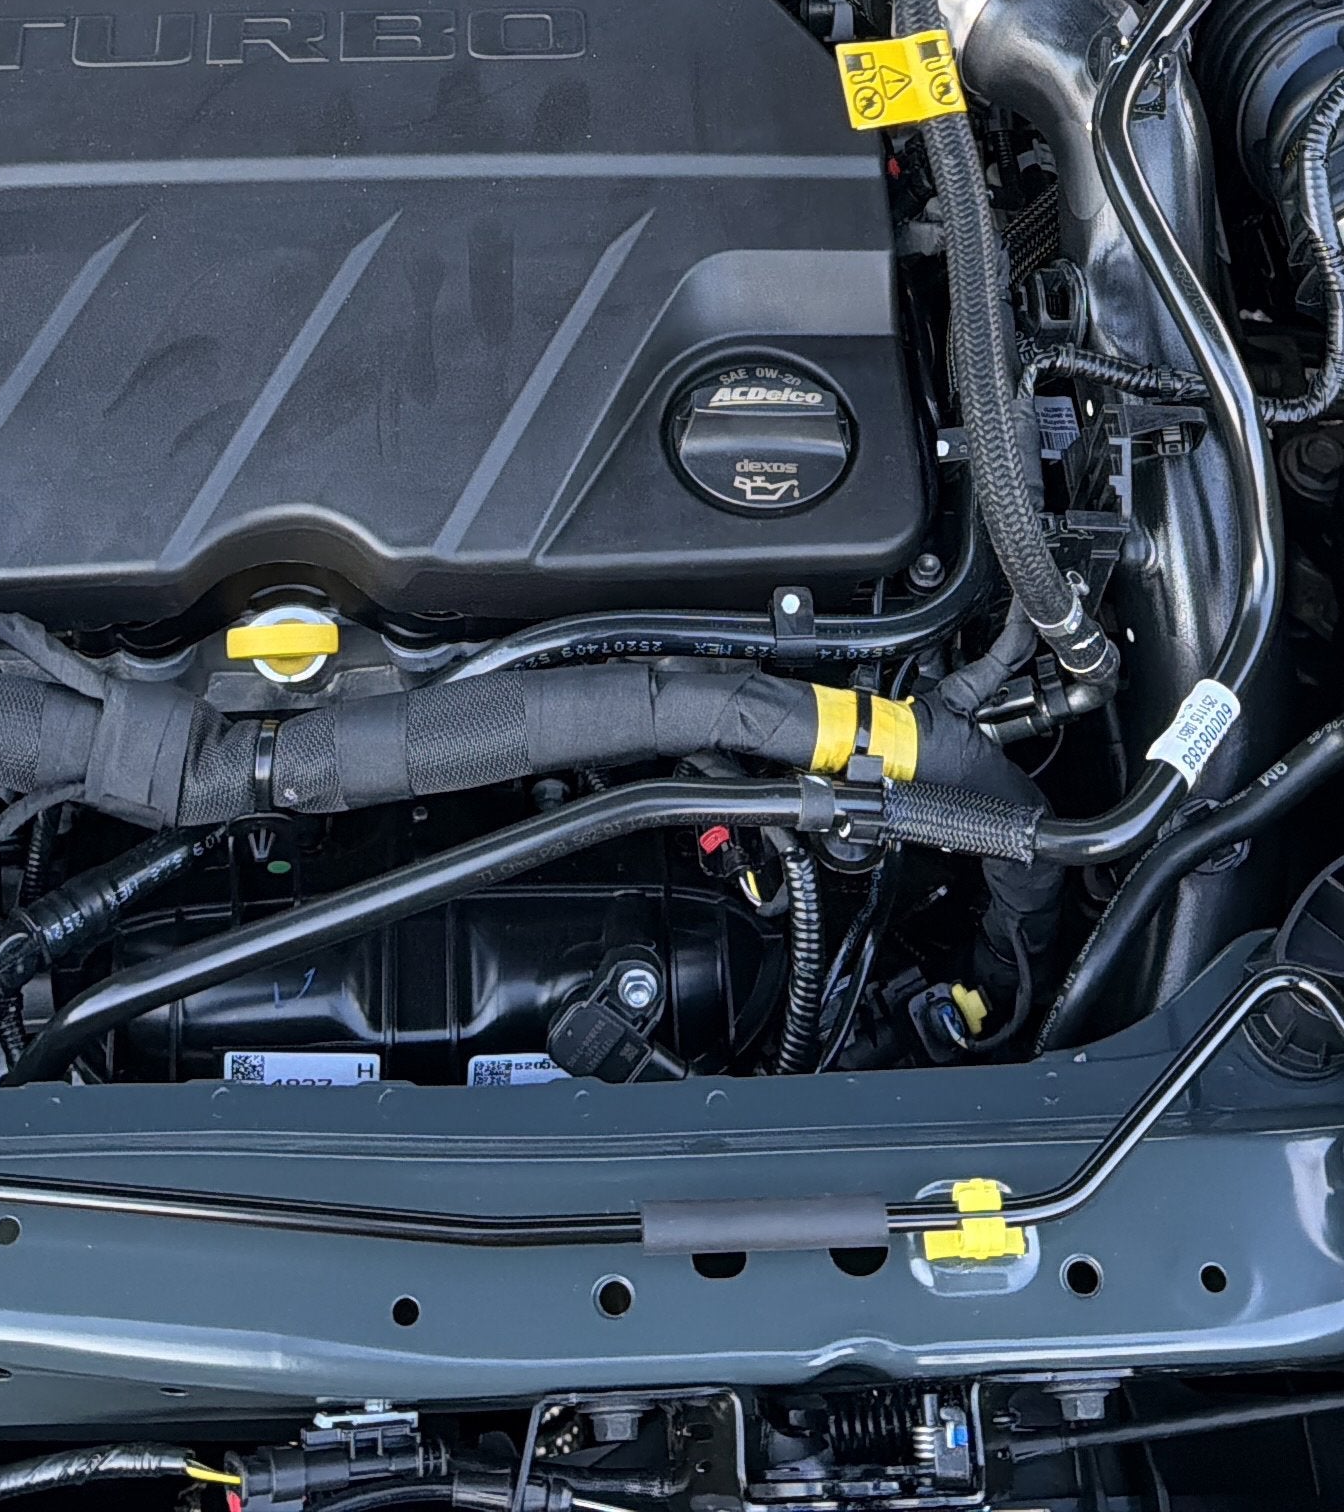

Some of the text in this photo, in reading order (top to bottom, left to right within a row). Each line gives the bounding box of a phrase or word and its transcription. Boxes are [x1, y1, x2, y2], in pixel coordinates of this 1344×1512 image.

[719, 367, 802, 386] SAE 0W-20
[710, 386, 823, 404] ACDelco
[735, 459, 799, 473] dexos
[694, 642, 732, 656] MEX
[1181, 702, 1233, 771] 60008388
[1256, 760, 1289, 787] GM
[357, 1062, 374, 1079] H
